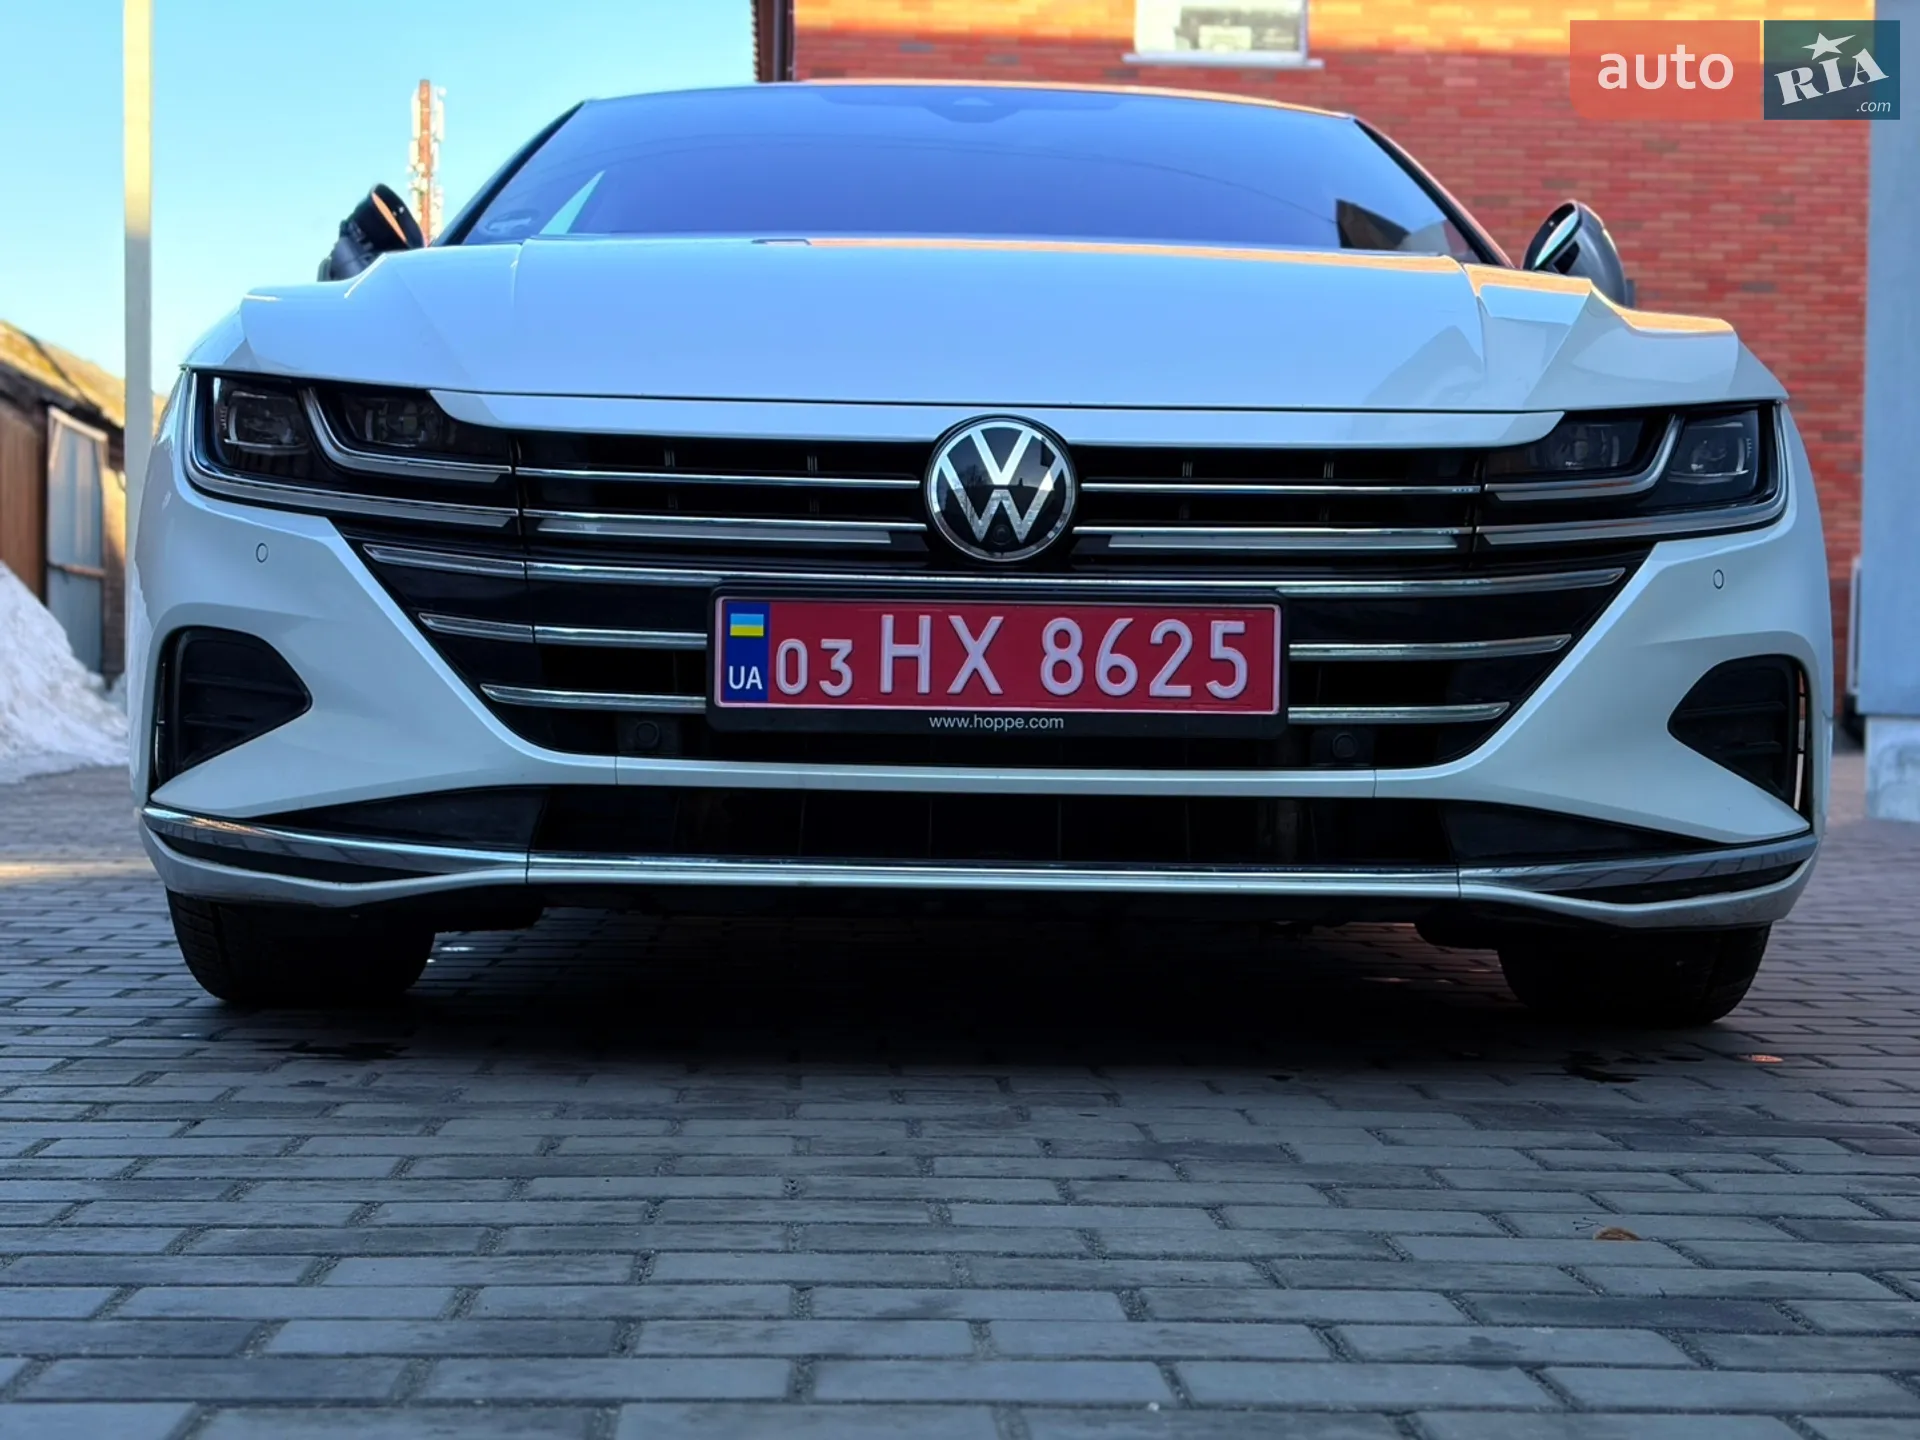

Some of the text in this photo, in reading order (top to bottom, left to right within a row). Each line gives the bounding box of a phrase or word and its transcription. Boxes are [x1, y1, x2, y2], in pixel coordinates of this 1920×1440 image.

[775, 614, 1248, 699] 03 HX 8625
[728, 665, 763, 690] UA
[929, 715, 1065, 732] www.hoppe.com
